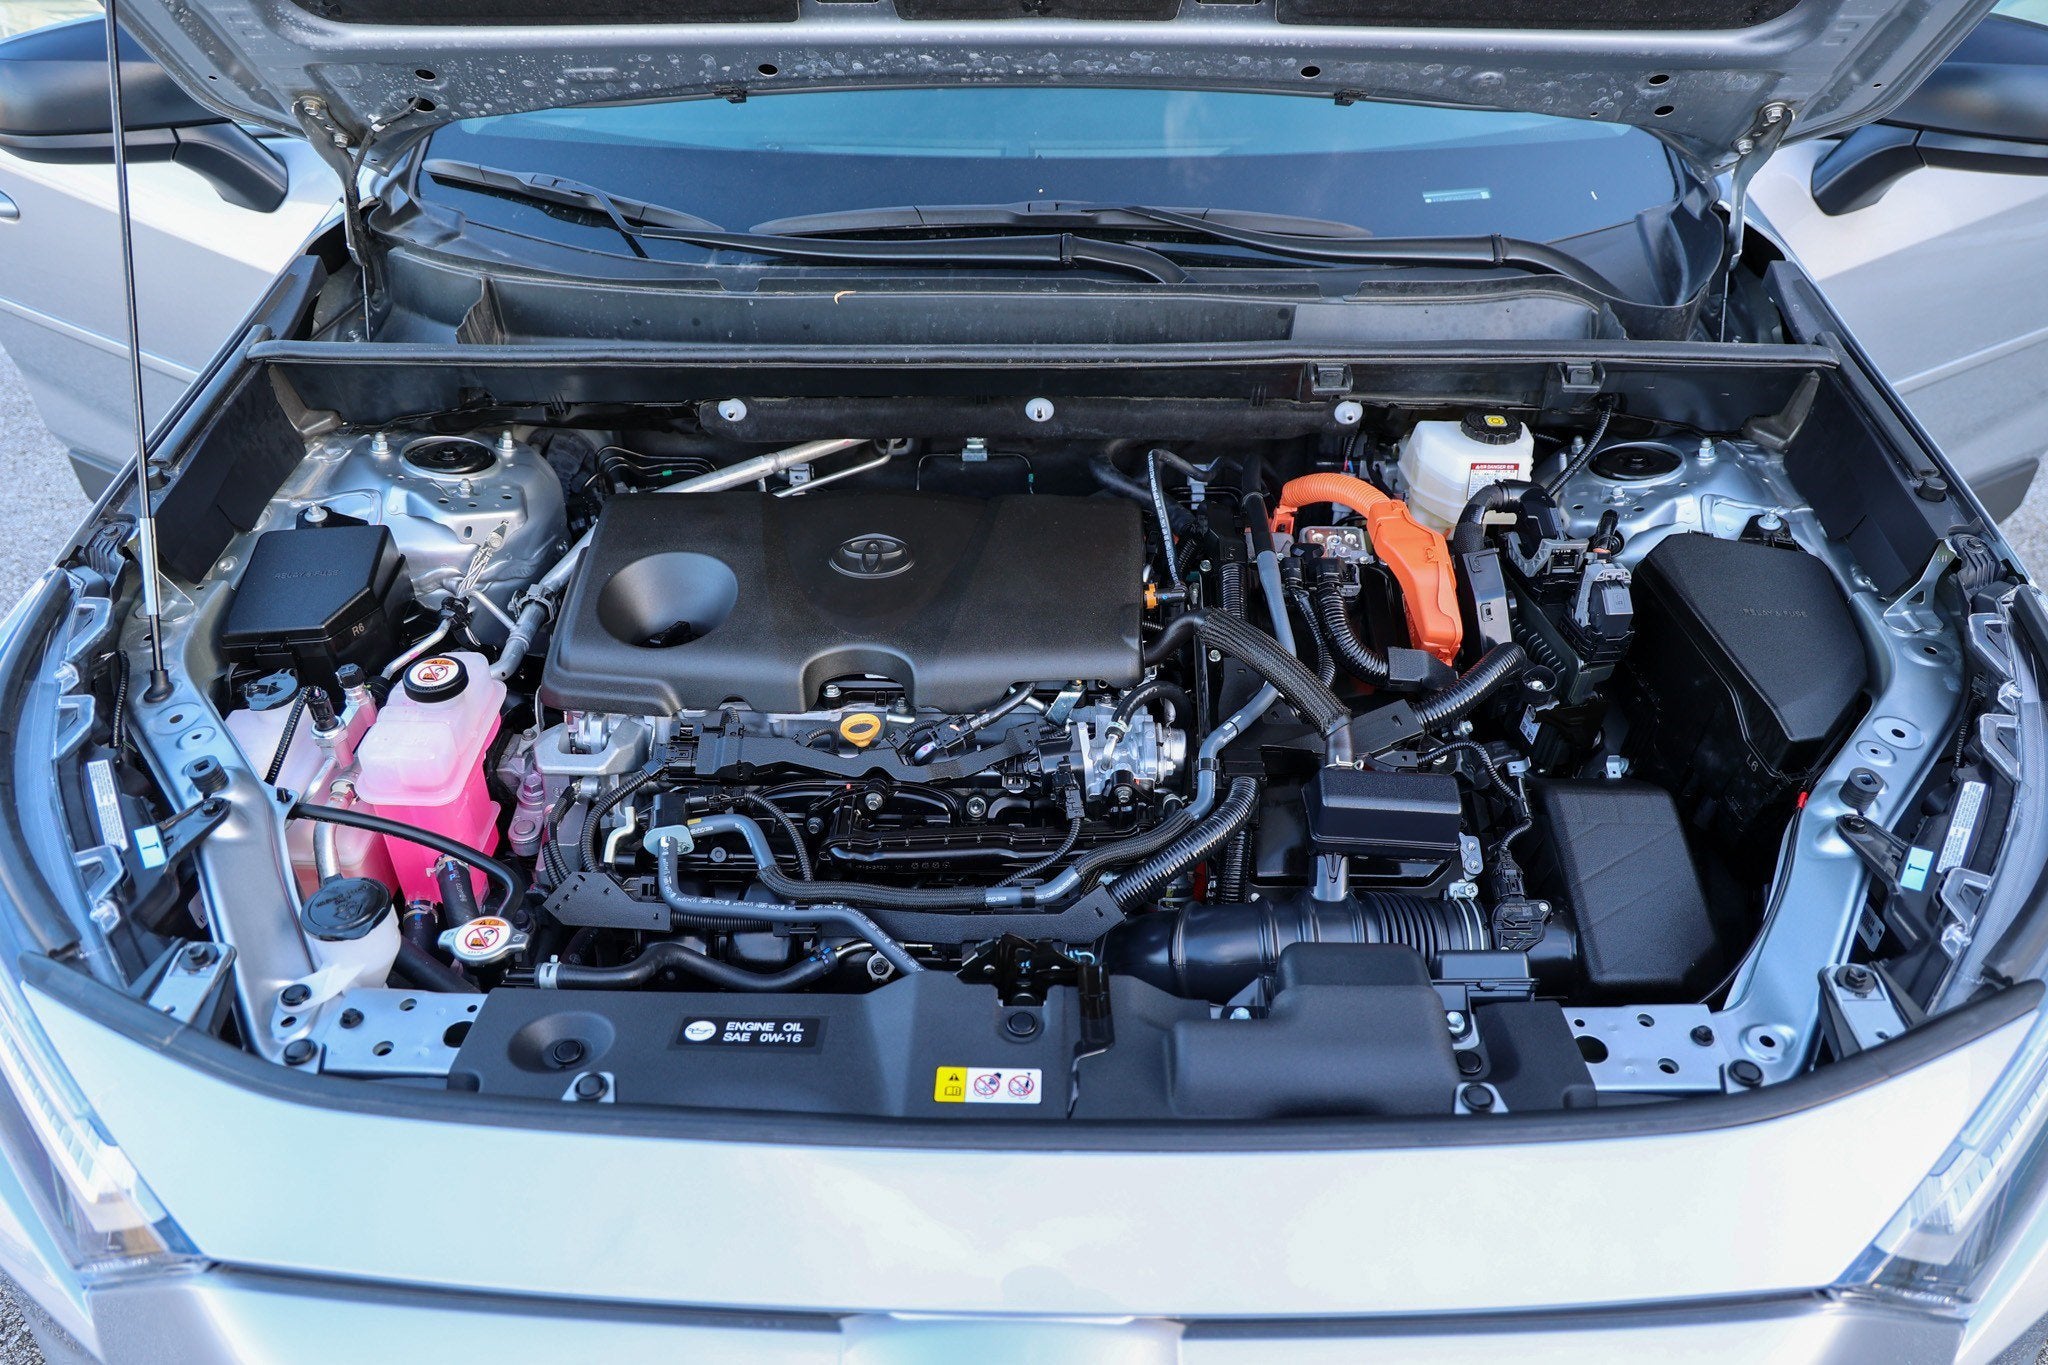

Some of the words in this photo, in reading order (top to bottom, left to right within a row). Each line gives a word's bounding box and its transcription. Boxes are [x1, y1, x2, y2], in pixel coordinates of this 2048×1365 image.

[351, 623, 365, 636] R6
[1746, 754, 1758, 772] L6
[1907, 863, 1925, 872] T
[725, 1021, 775, 1032] ENGINE
[782, 1022, 804, 1032] OIL
[722, 1032, 751, 1042] SAE
[759, 1033, 802, 1043] 0W-16
